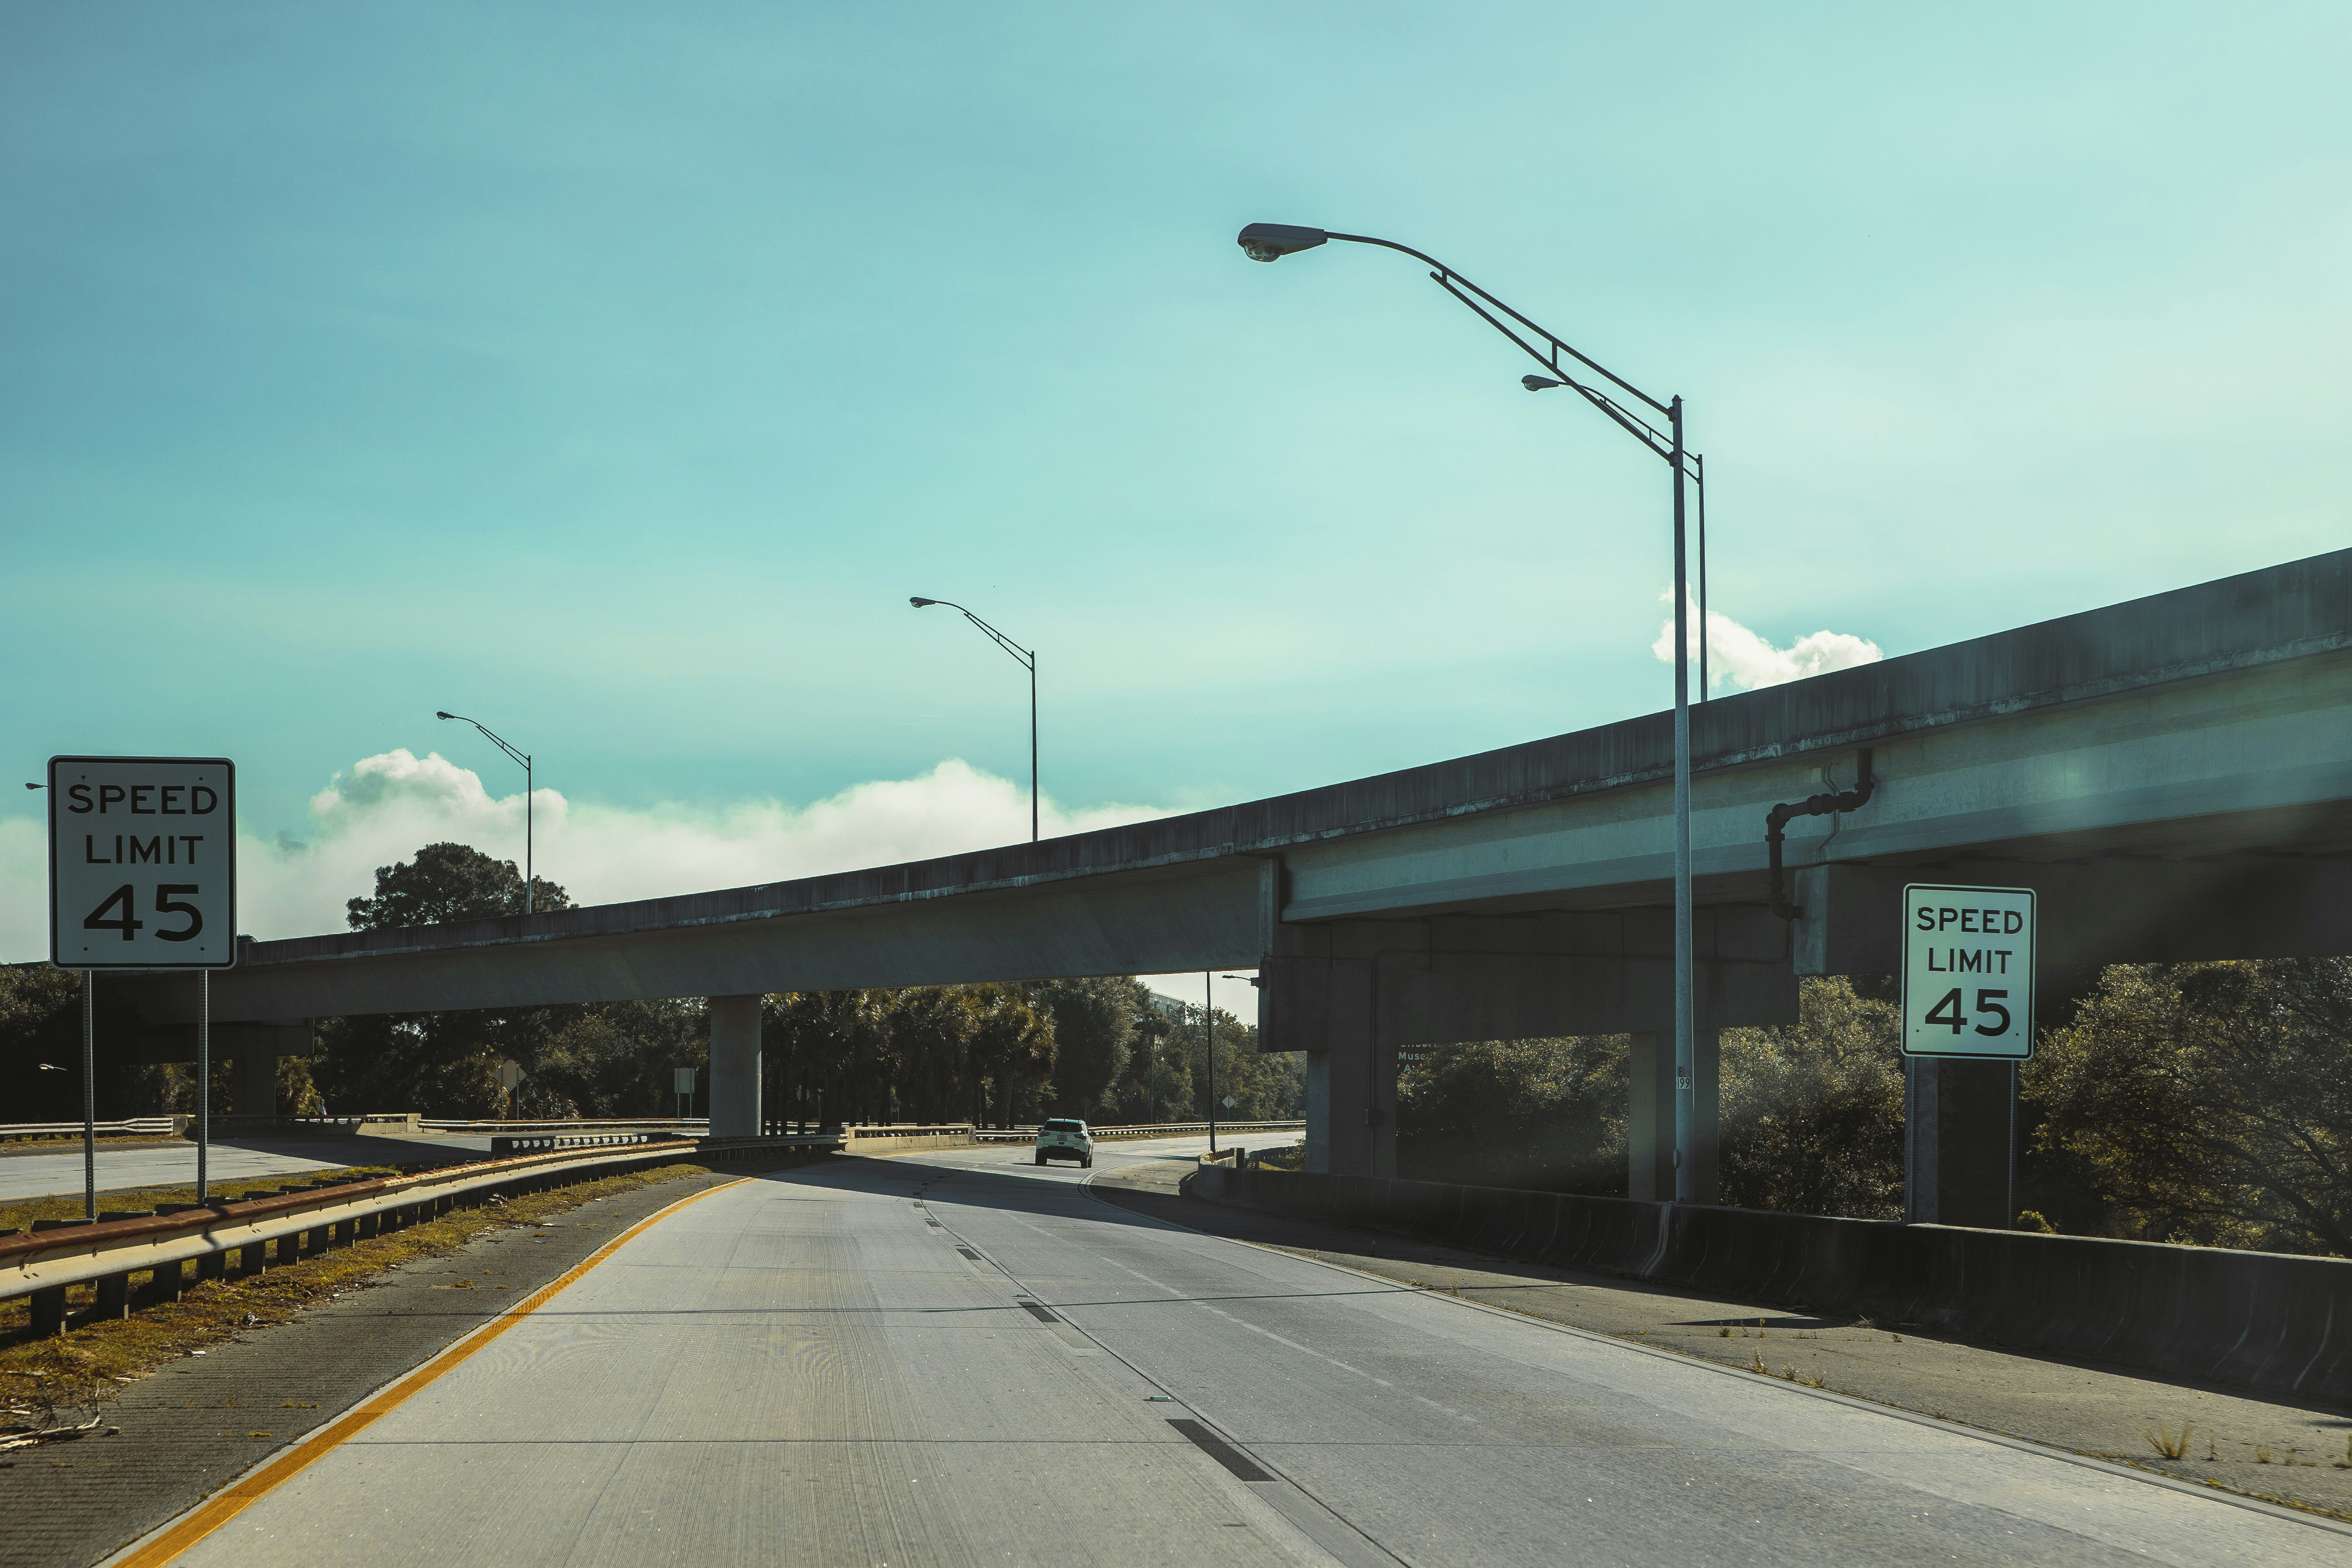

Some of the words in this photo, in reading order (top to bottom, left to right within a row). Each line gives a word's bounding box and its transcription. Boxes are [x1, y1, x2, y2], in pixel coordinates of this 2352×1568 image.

[68, 784, 217, 815] SPEED
[86, 834, 203, 864] LIMIT
[84, 884, 202, 942] 45
[1917, 906, 2023, 934] SPEED
[1929, 948, 2012, 974] LIMIT
[1925, 988, 2010, 1036] 45
[1399, 1052, 1432, 1060] Museu
